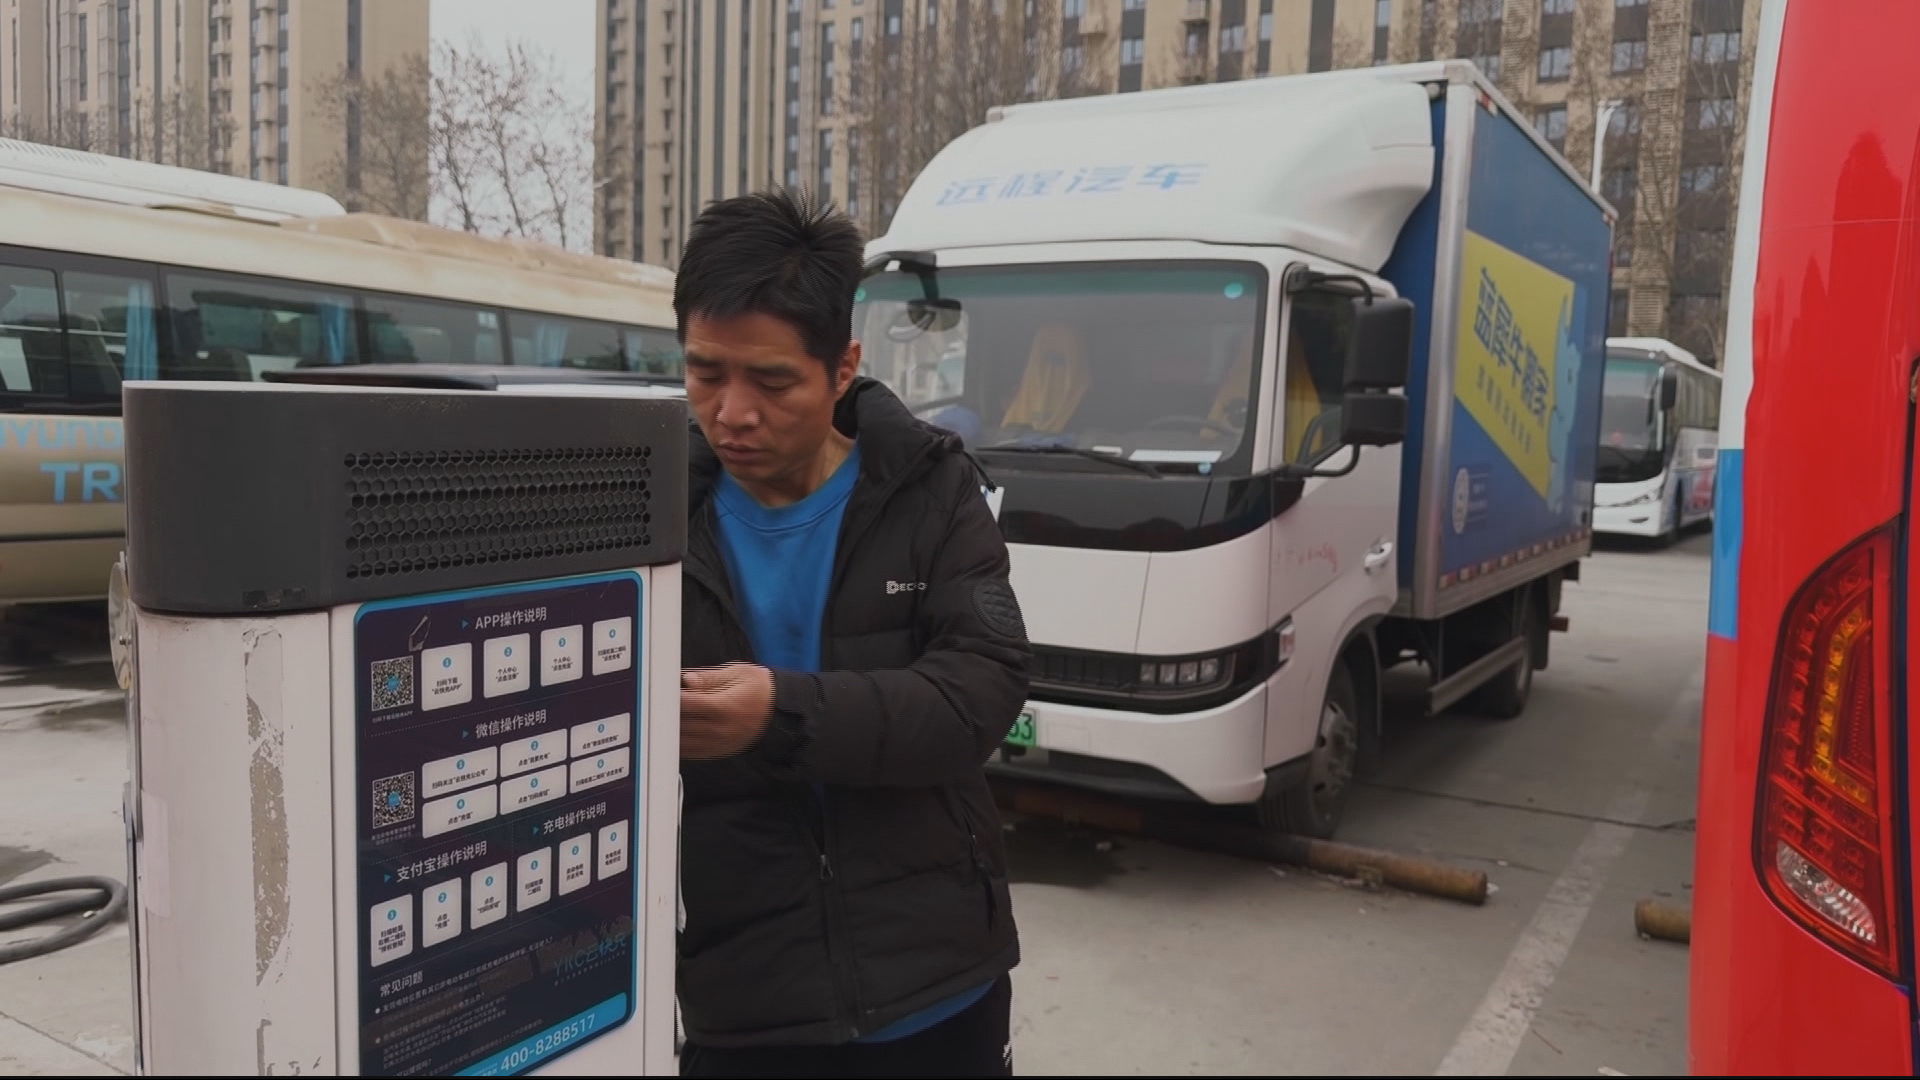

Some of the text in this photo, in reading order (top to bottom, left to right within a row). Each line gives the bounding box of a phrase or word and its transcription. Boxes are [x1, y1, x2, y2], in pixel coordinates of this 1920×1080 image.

[935, 162, 1208, 207] 远程汽车
[0, 419, 122, 449] YUND
[39, 462, 122, 503] TR
[475, 606, 547, 630] APP操作说明
[475, 709, 547, 739] 微信操作说明
[543, 801, 606, 835] 充电操作说明
[396, 840, 487, 883] 支付宝操作说明
[380, 970, 424, 998] 常见问题
[501, 1013, 596, 1071] 400-8288517
